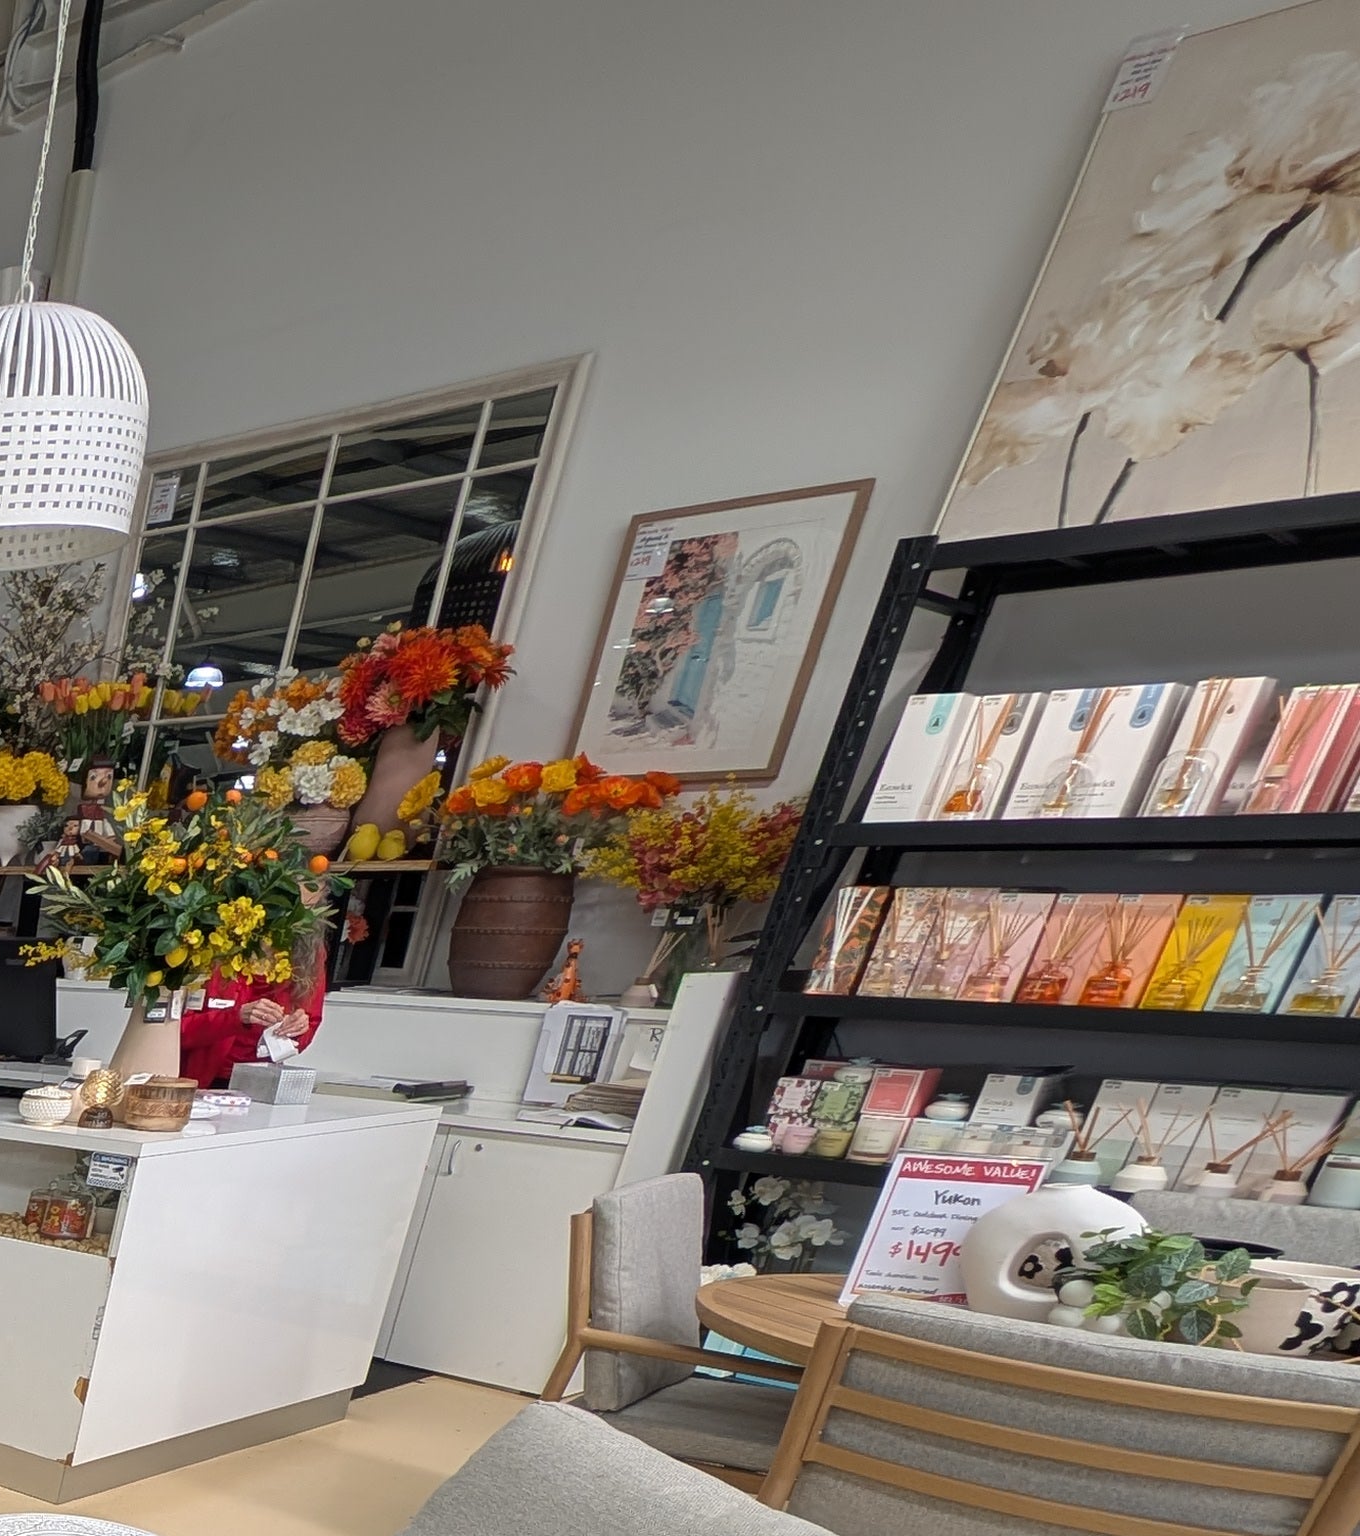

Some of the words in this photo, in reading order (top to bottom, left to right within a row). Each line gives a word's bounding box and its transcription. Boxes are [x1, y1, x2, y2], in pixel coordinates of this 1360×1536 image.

[902, 1160, 976, 1177] AWESOME
[983, 1166, 1037, 1181] VALUE!
[934, 1189, 982, 1206] Yukon
